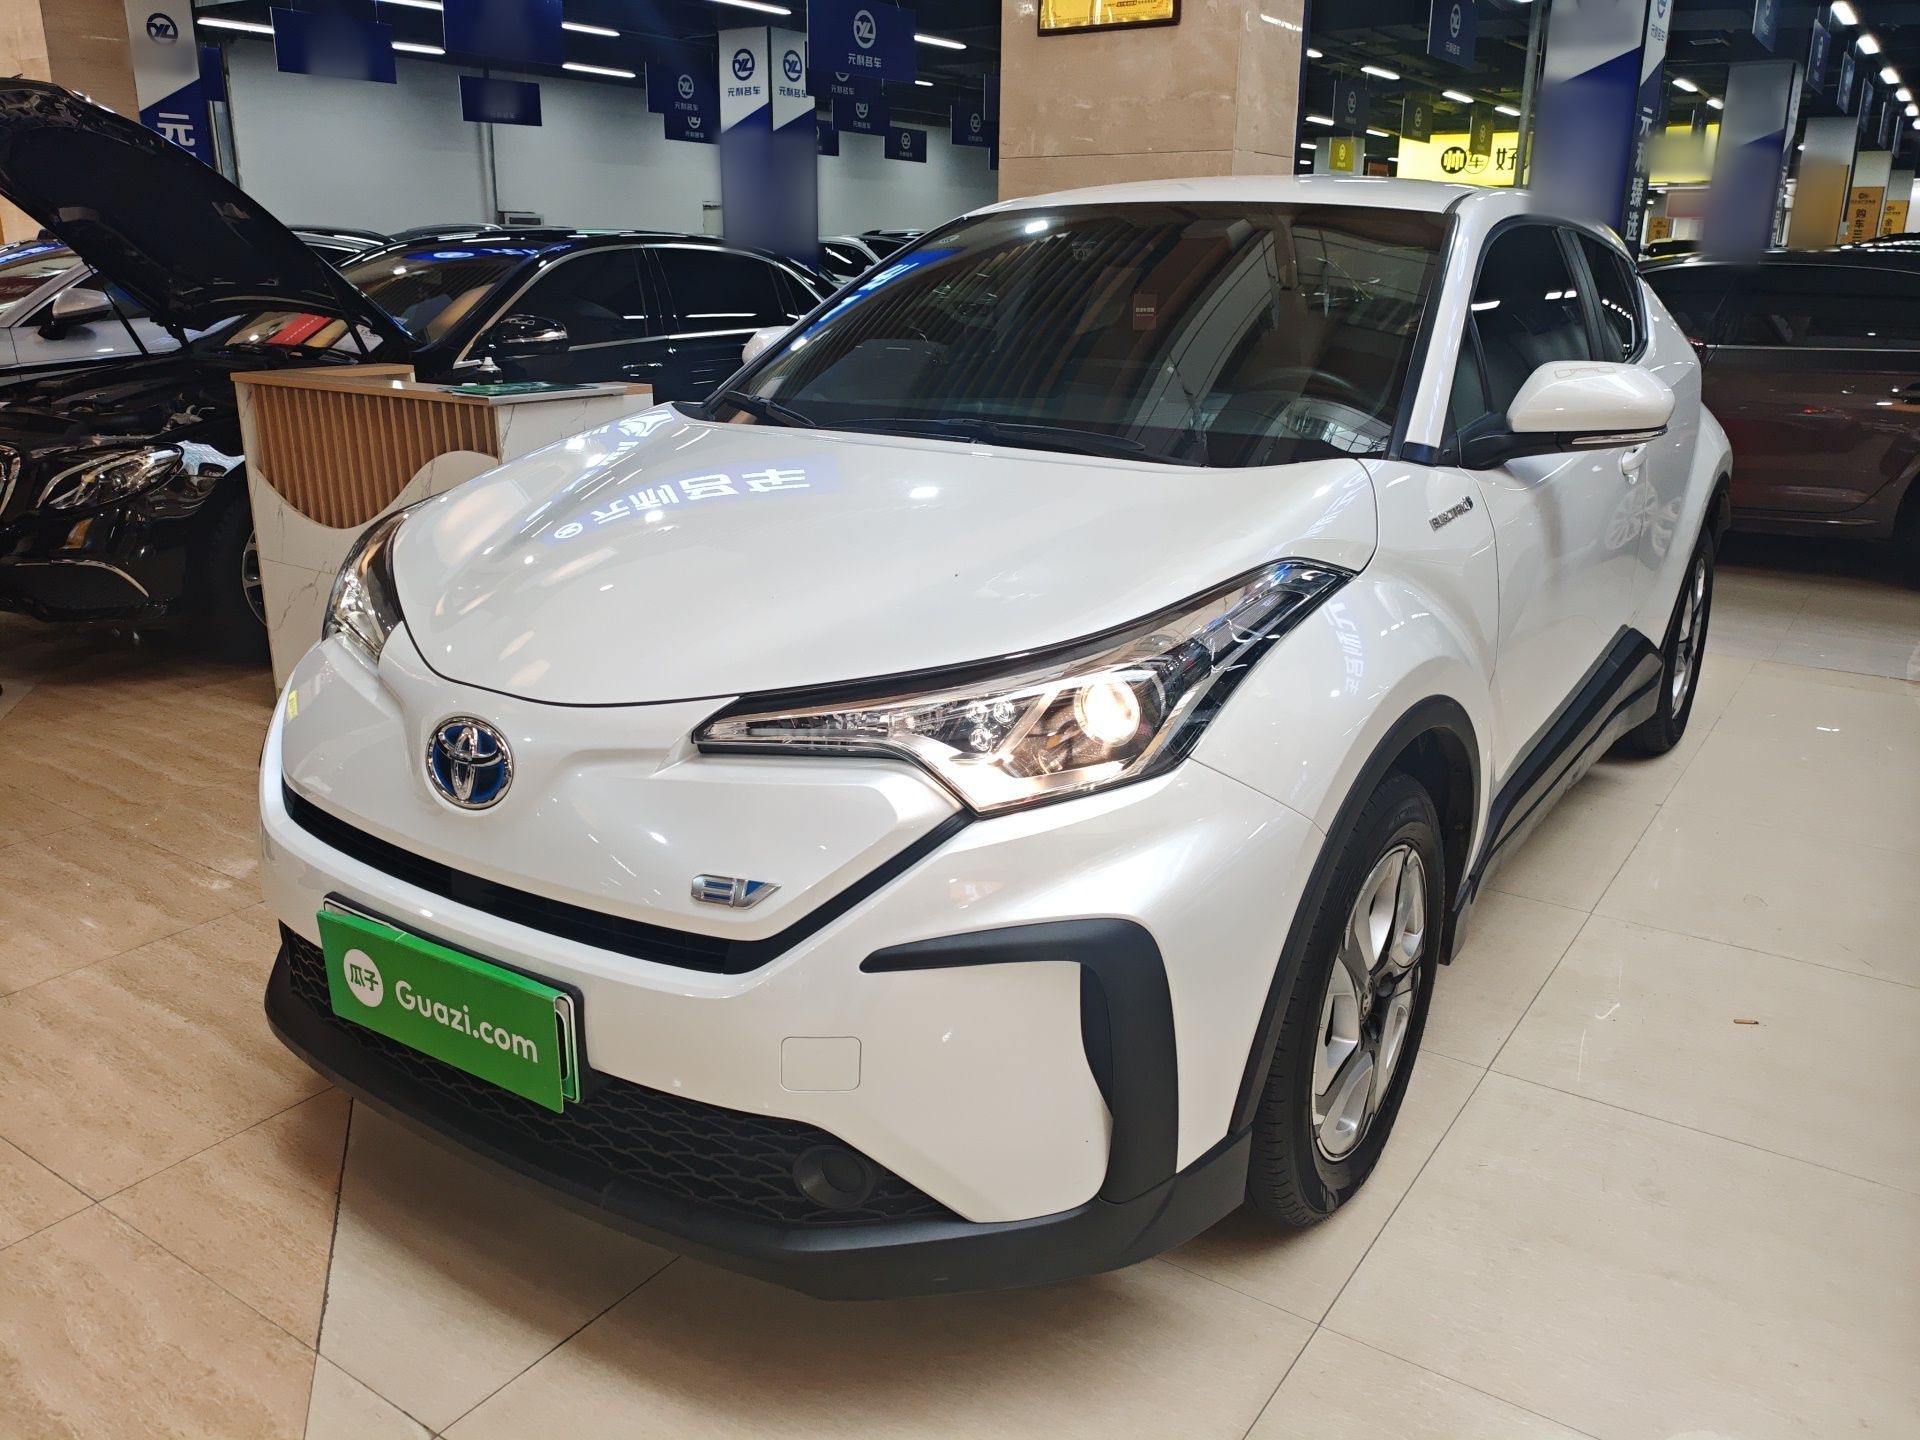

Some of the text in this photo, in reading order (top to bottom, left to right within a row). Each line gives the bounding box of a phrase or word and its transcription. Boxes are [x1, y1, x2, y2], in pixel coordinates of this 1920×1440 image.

[848, 52, 882, 69] 元利名车
[727, 86, 761, 97] 元利名车
[349, 962, 379, 992] 瓜子
[395, 980, 539, 1064] Guazi.com
